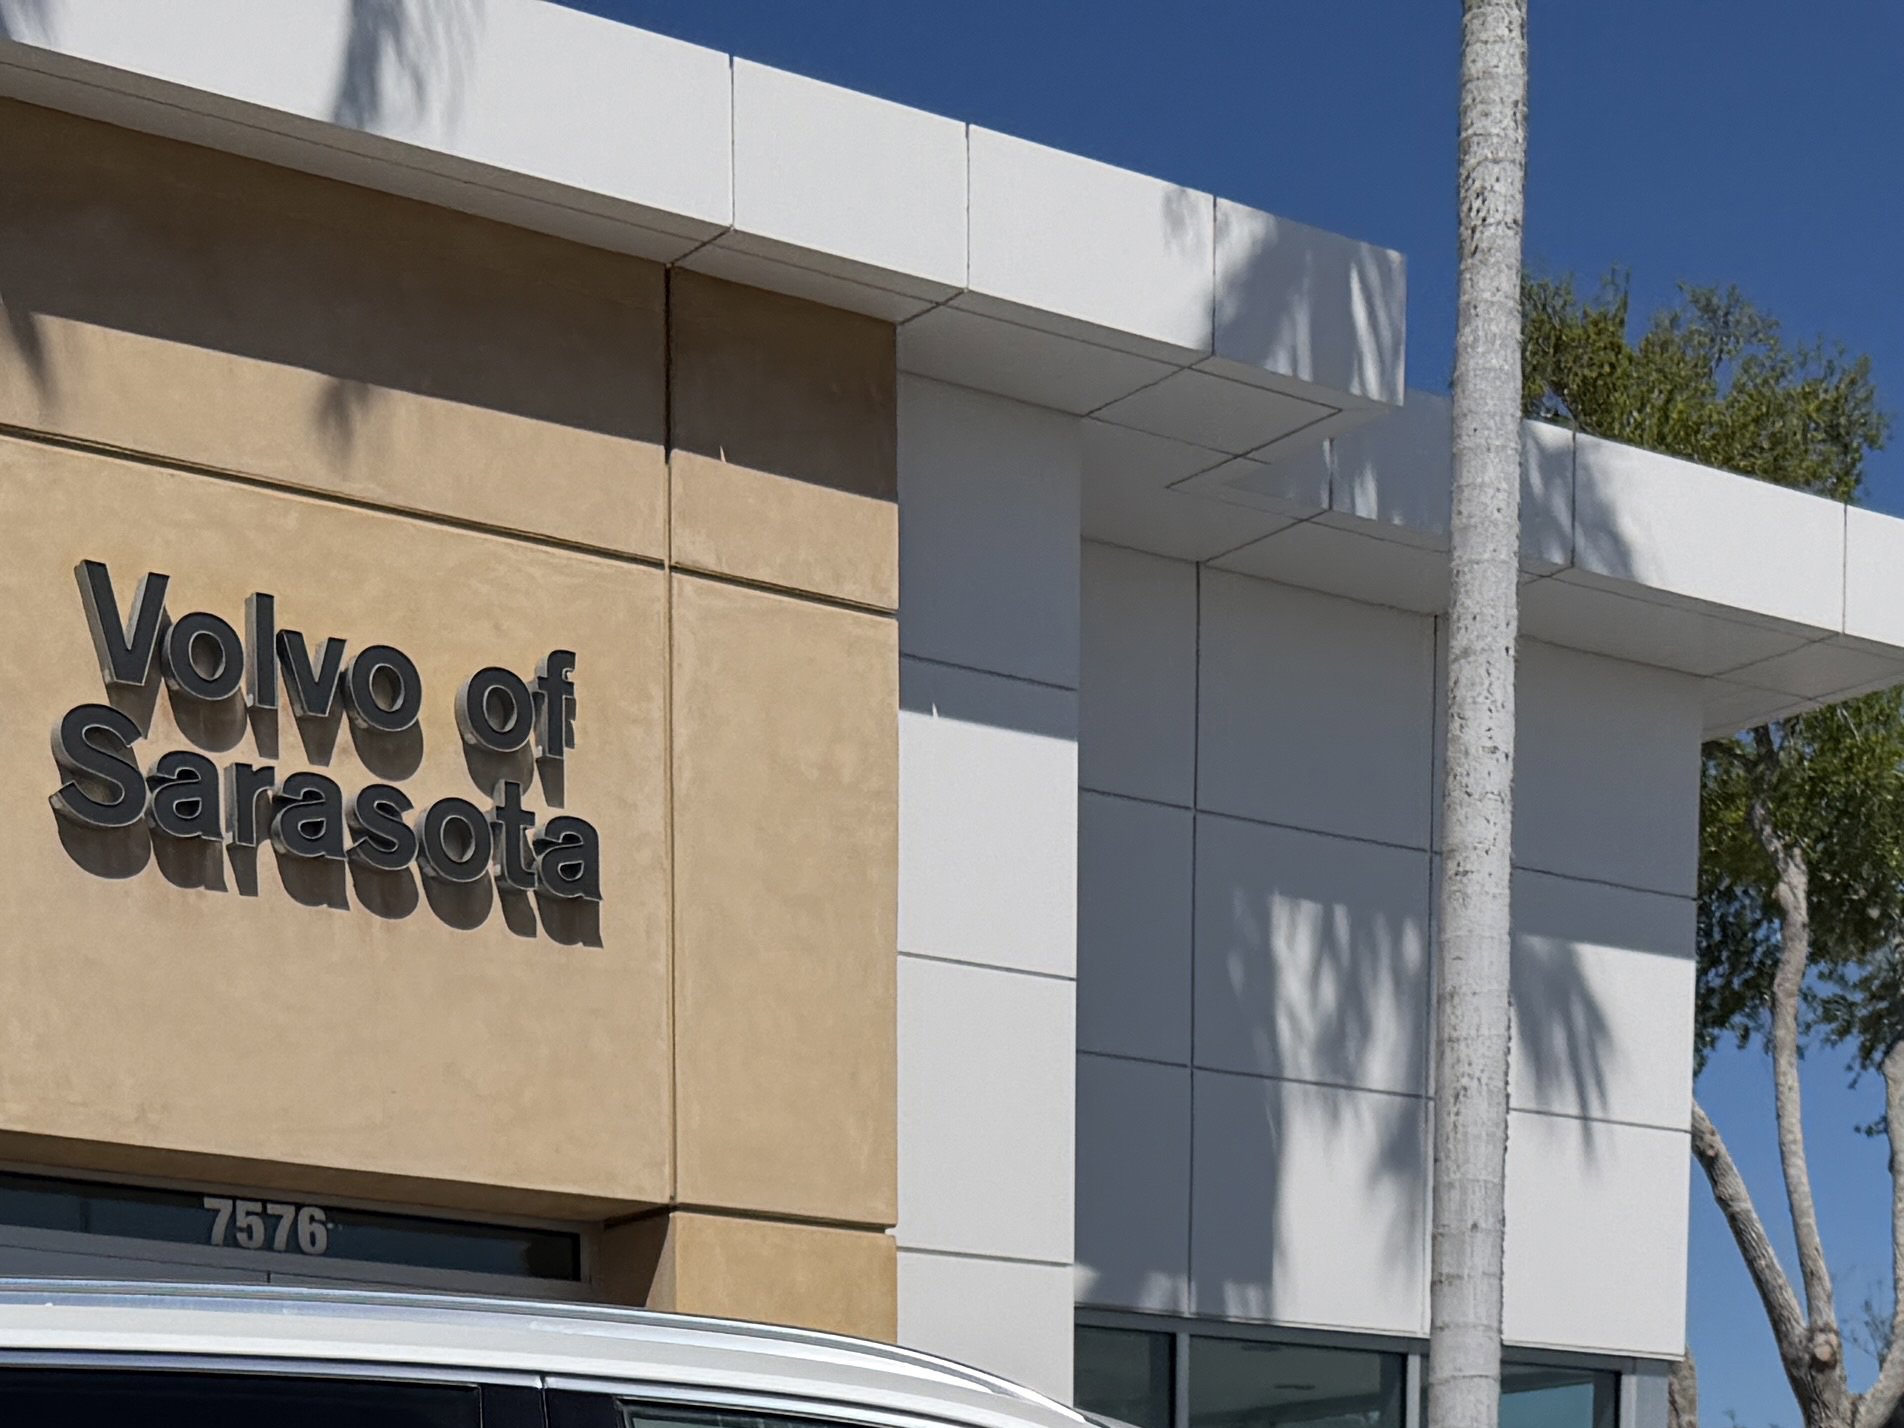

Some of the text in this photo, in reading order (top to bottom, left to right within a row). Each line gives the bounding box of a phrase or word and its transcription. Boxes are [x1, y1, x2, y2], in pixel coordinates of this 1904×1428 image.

[74, 559, 576, 757] Volvo of
[49, 703, 602, 900] Sarasota
[203, 1197, 328, 1255] 7576
